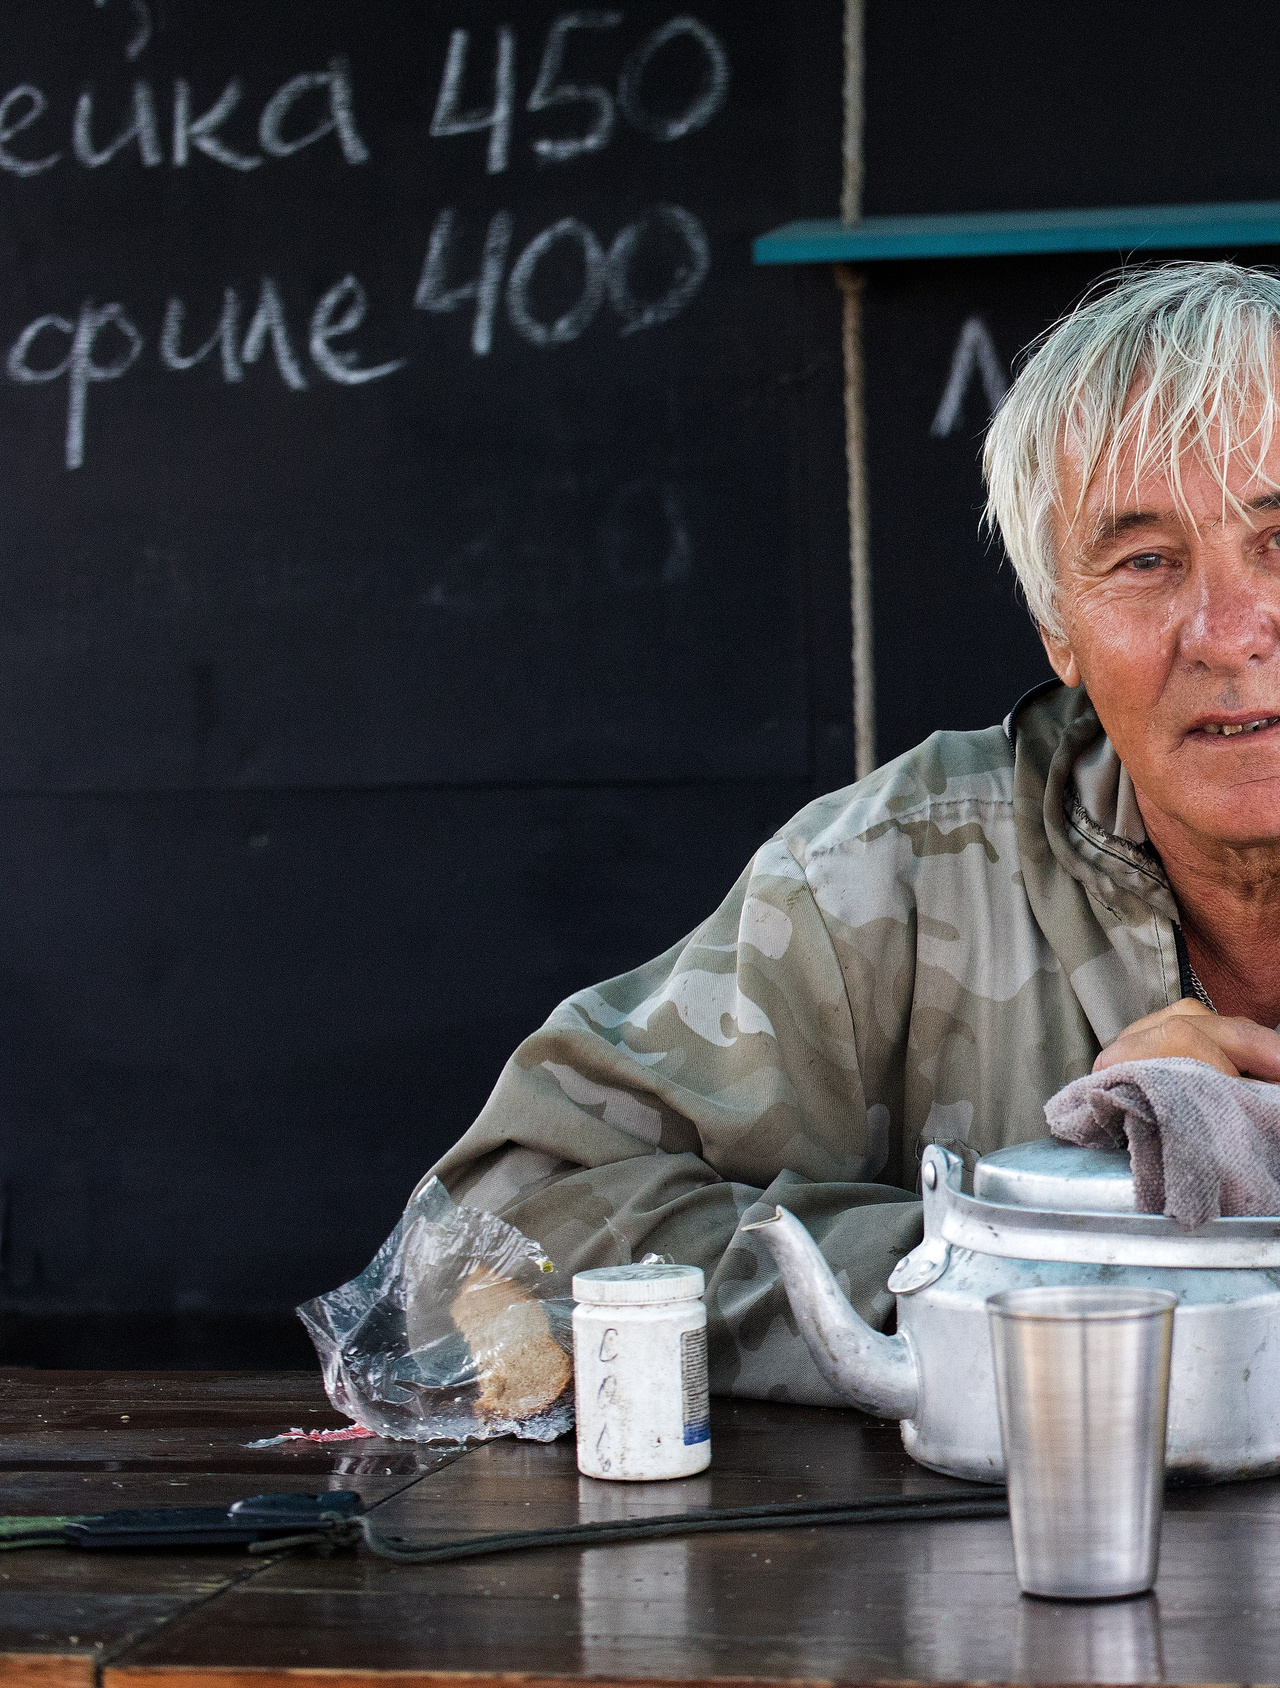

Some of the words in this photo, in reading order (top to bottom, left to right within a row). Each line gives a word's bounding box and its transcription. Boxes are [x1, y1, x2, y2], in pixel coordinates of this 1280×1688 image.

[429, 12, 729, 174] 450
[6, 275, 405, 470] филе
[414, 204, 711, 355] 400
